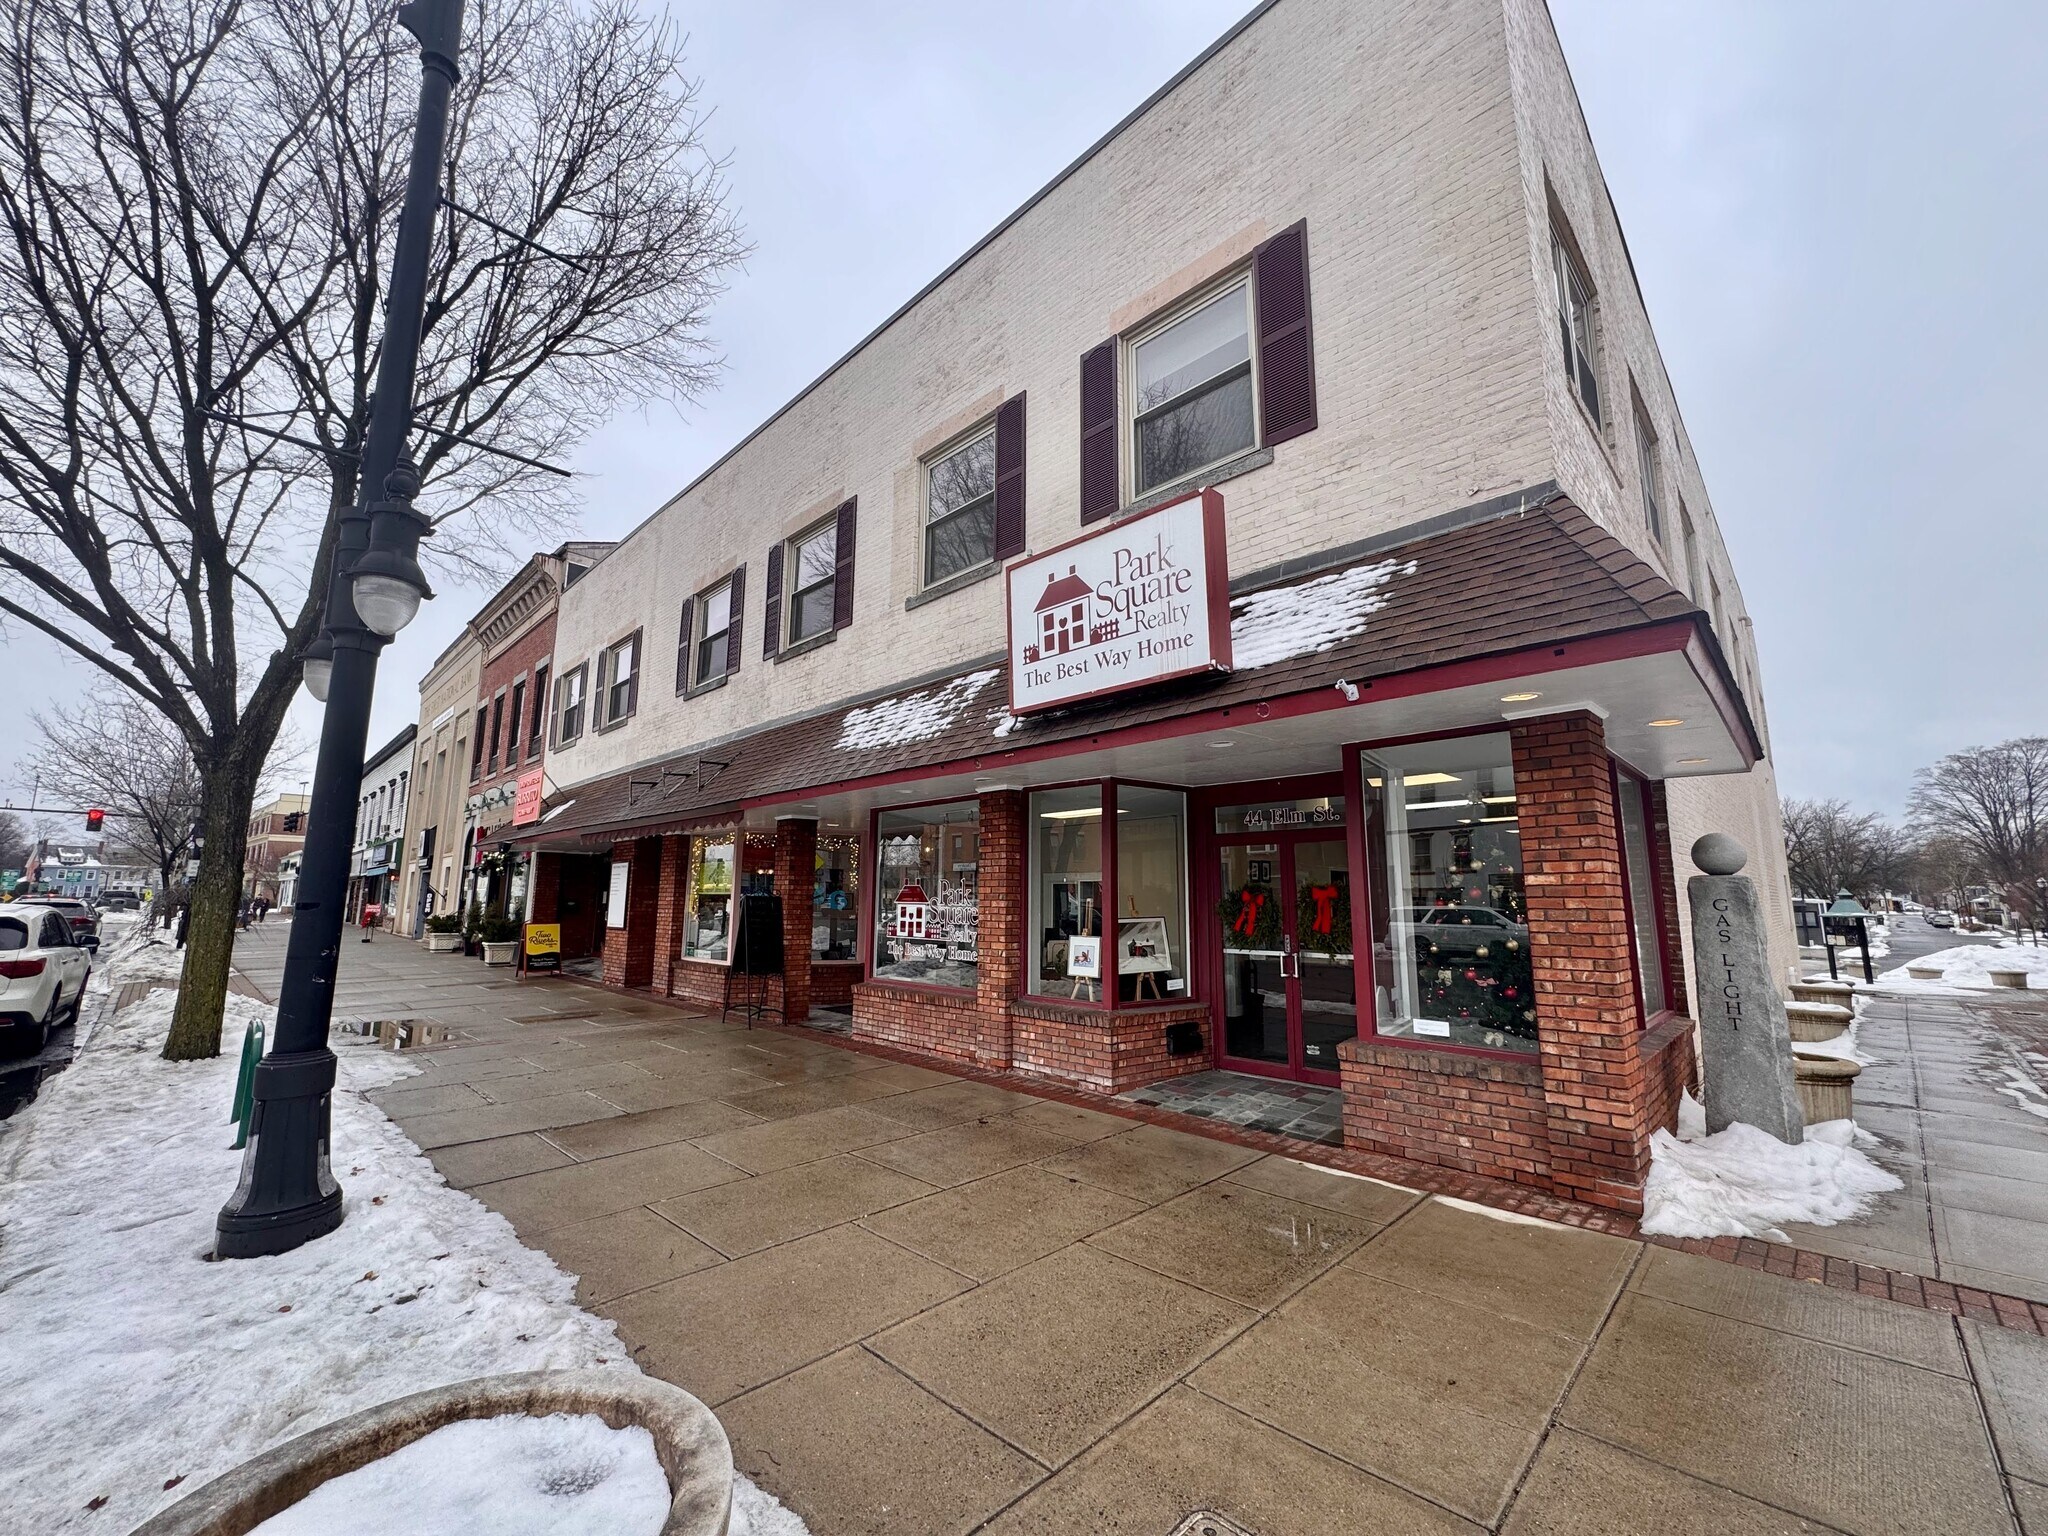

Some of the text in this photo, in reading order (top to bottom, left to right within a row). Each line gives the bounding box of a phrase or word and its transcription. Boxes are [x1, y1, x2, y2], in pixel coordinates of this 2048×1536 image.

[1112, 532, 1176, 587] Park
[1095, 567, 1193, 621] Square
[1134, 600, 1191, 633] Realty
[1024, 632, 1194, 688] The Best Way Home
[1243, 805, 1340, 827] 44 Elm St.
[938, 877, 973, 907] Park
[928, 896, 980, 931] Square
[535, 930, 552, 939] Two
[947, 924, 978, 948] Realty
[886, 940, 978, 963] The Best Way Home
[1712, 898, 1743, 1031] GAS LIGHT
